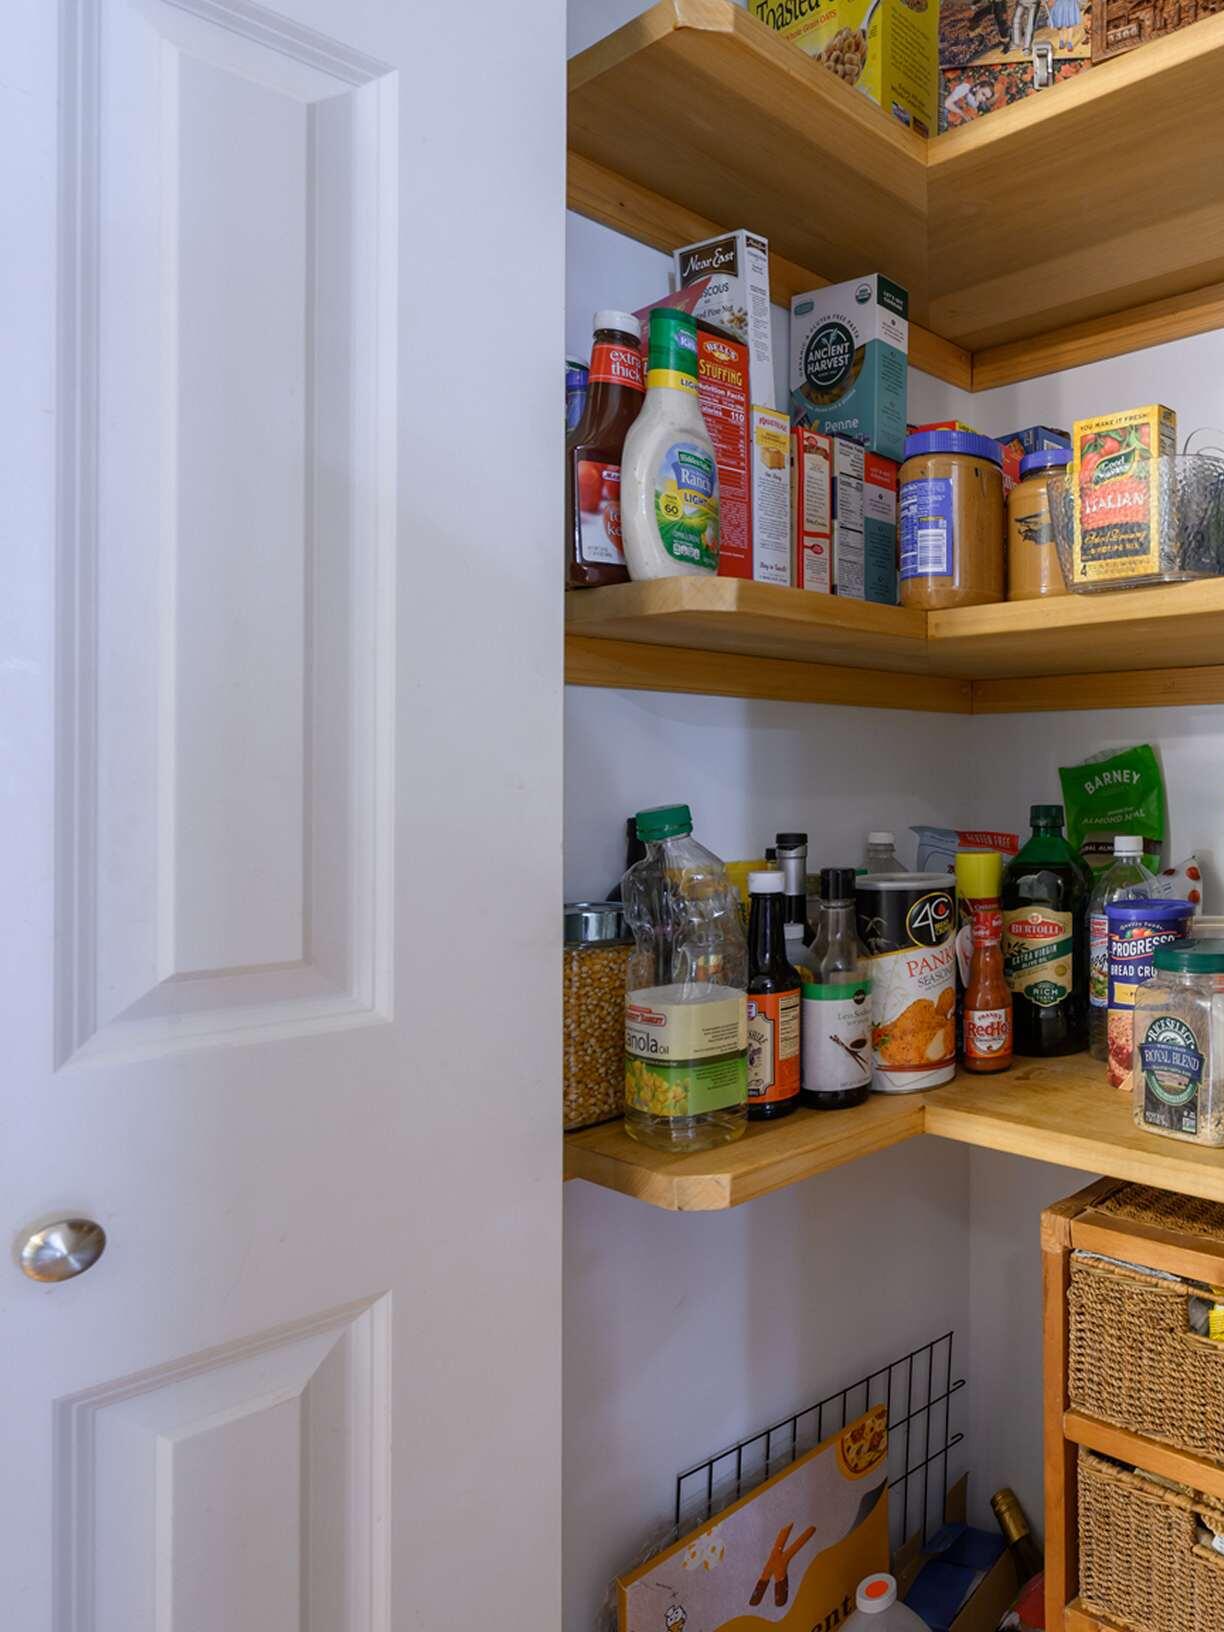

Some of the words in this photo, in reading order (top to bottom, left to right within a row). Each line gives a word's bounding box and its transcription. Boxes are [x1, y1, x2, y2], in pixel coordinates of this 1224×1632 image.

[682, 254, 712, 277] Near
[712, 247, 735, 268] East
[703, 282, 729, 298] SCOUS
[610, 350, 641, 369] extra
[808, 342, 850, 362] ANCIENT
[611, 363, 642, 383] thick
[699, 358, 743, 387] STUFFING
[807, 355, 850, 375] HARVEST
[824, 418, 859, 432] Penne
[681, 467, 712, 492] Ranch
[1085, 492, 1145, 514] ITALIAN
[1084, 769, 1141, 795] BARNEY
[911, 898, 950, 942] 4C
[1011, 924, 1059, 935] BERTOLLI
[905, 945, 955, 977] PANK
[1012, 951, 1034, 965] EXTRA
[1034, 944, 1057, 958] VIRGIN
[1111, 964, 1135, 977] BREAD
[1033, 987, 1059, 996] RICH
[967, 1021, 1008, 1037] RedHo
[1149, 1018, 1194, 1045] RICESELECT
[626, 1032, 658, 1054] anola
[1144, 1049, 1172, 1064] ROYAL
[1172, 1052, 1200, 1072] BLEND
